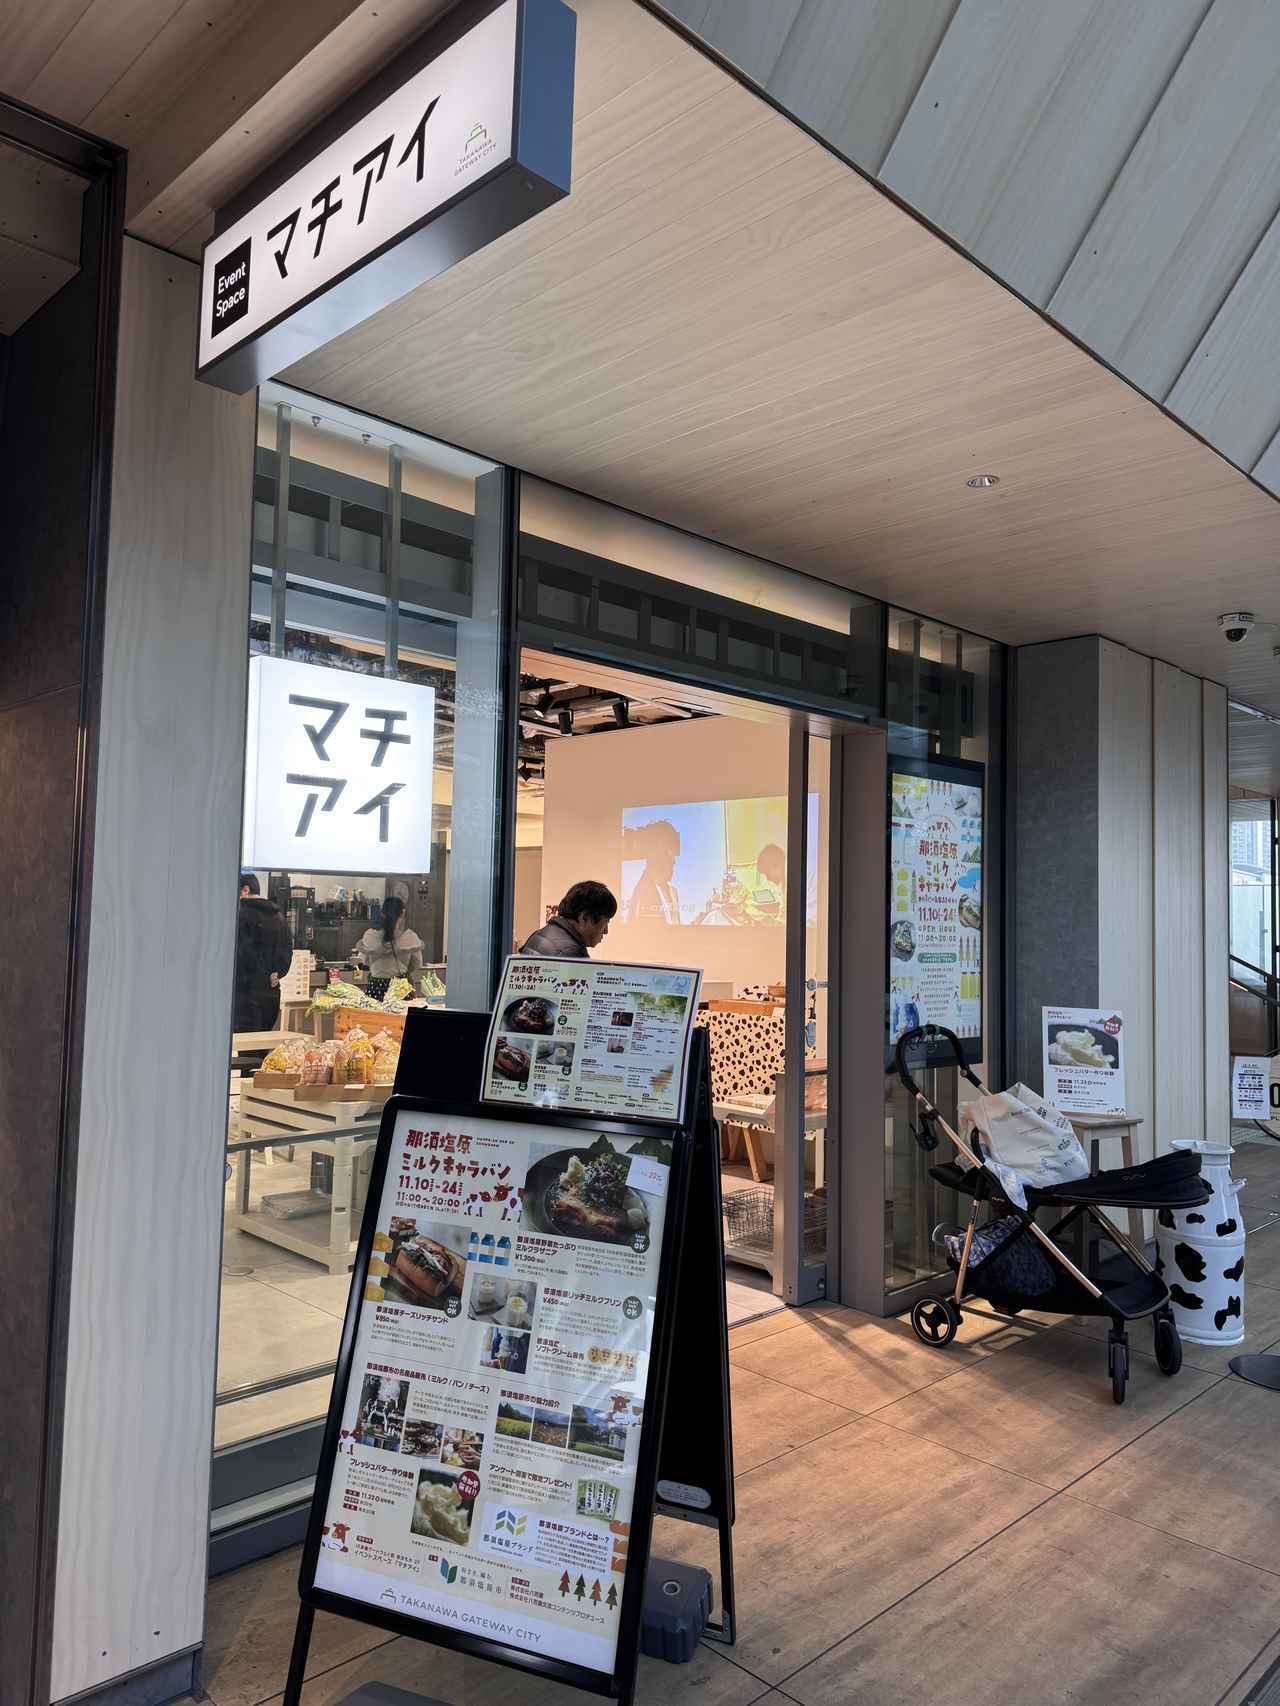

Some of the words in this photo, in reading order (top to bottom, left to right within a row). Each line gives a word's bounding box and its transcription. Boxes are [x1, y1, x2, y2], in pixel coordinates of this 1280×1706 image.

[266, 94, 441, 280] マチアイ
[217, 261, 246, 294] Event
[215, 287, 246, 318] Space
[288, 693, 412, 768] マチ
[286, 773, 407, 843] アイ
[405, 1129, 473, 1155] 那須塩原
[401, 1152, 512, 1180] ミルクキャラバン
[400, 1594, 459, 1620] TAKANAWA
[461, 1612, 514, 1634] GATEWAY
[515, 1628, 542, 1643] CITY
